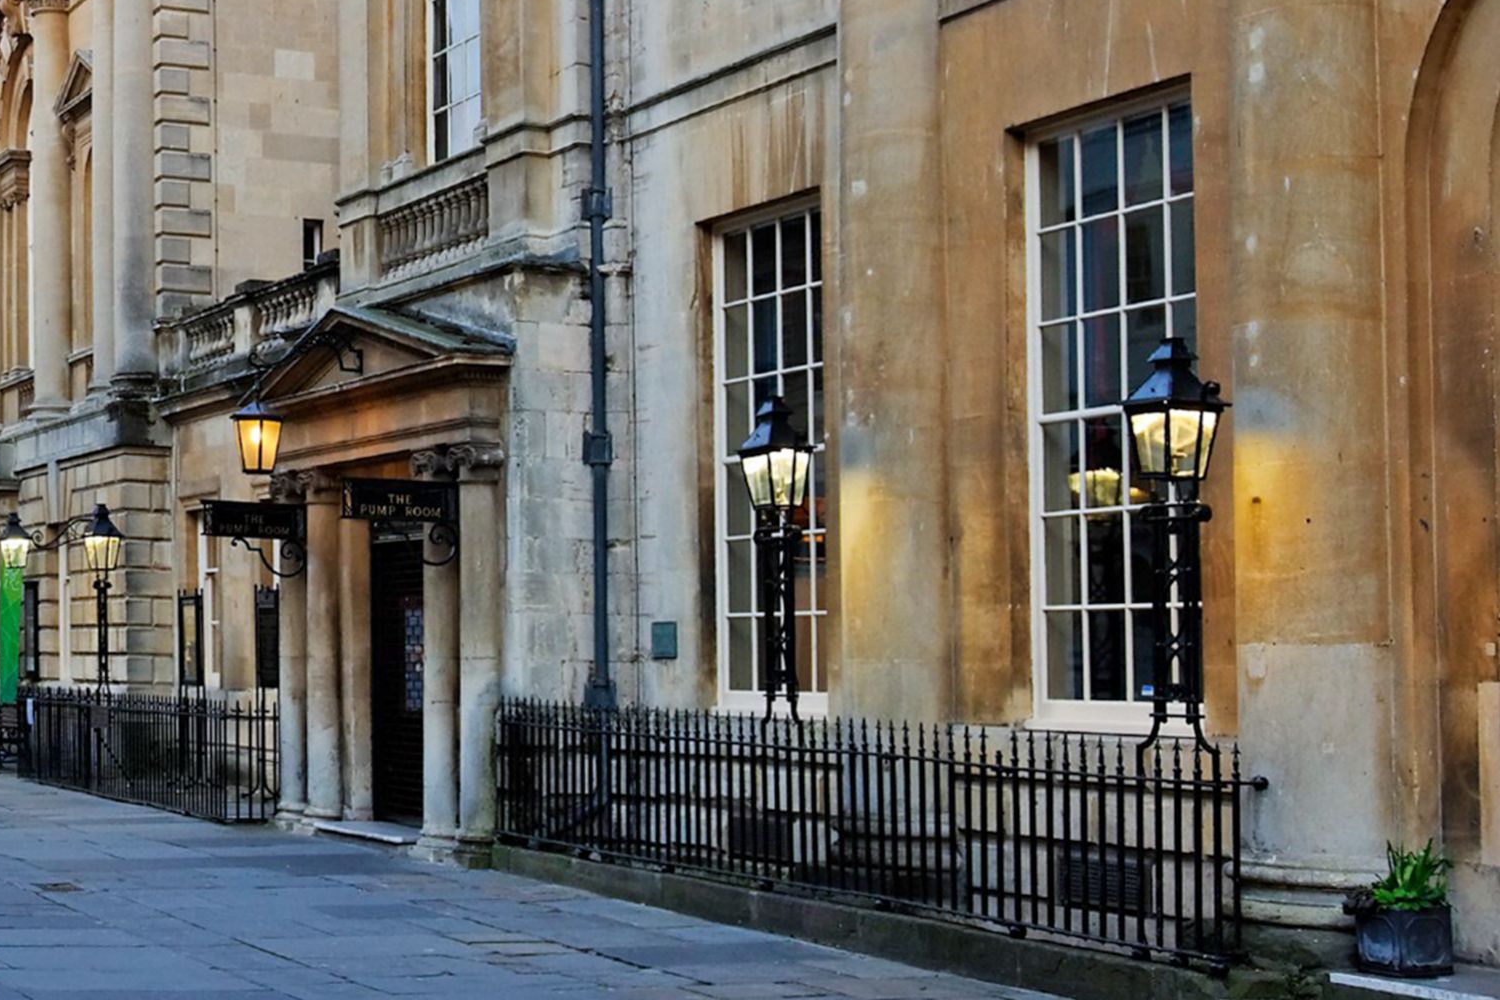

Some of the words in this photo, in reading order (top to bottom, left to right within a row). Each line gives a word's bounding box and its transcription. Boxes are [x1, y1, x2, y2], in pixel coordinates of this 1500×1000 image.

[387, 493, 412, 505] THE
[360, 504, 396, 516] PUMP
[405, 506, 441, 518] ROOM
[244, 513, 265, 524] THE
[219, 523, 250, 534] PUMP
